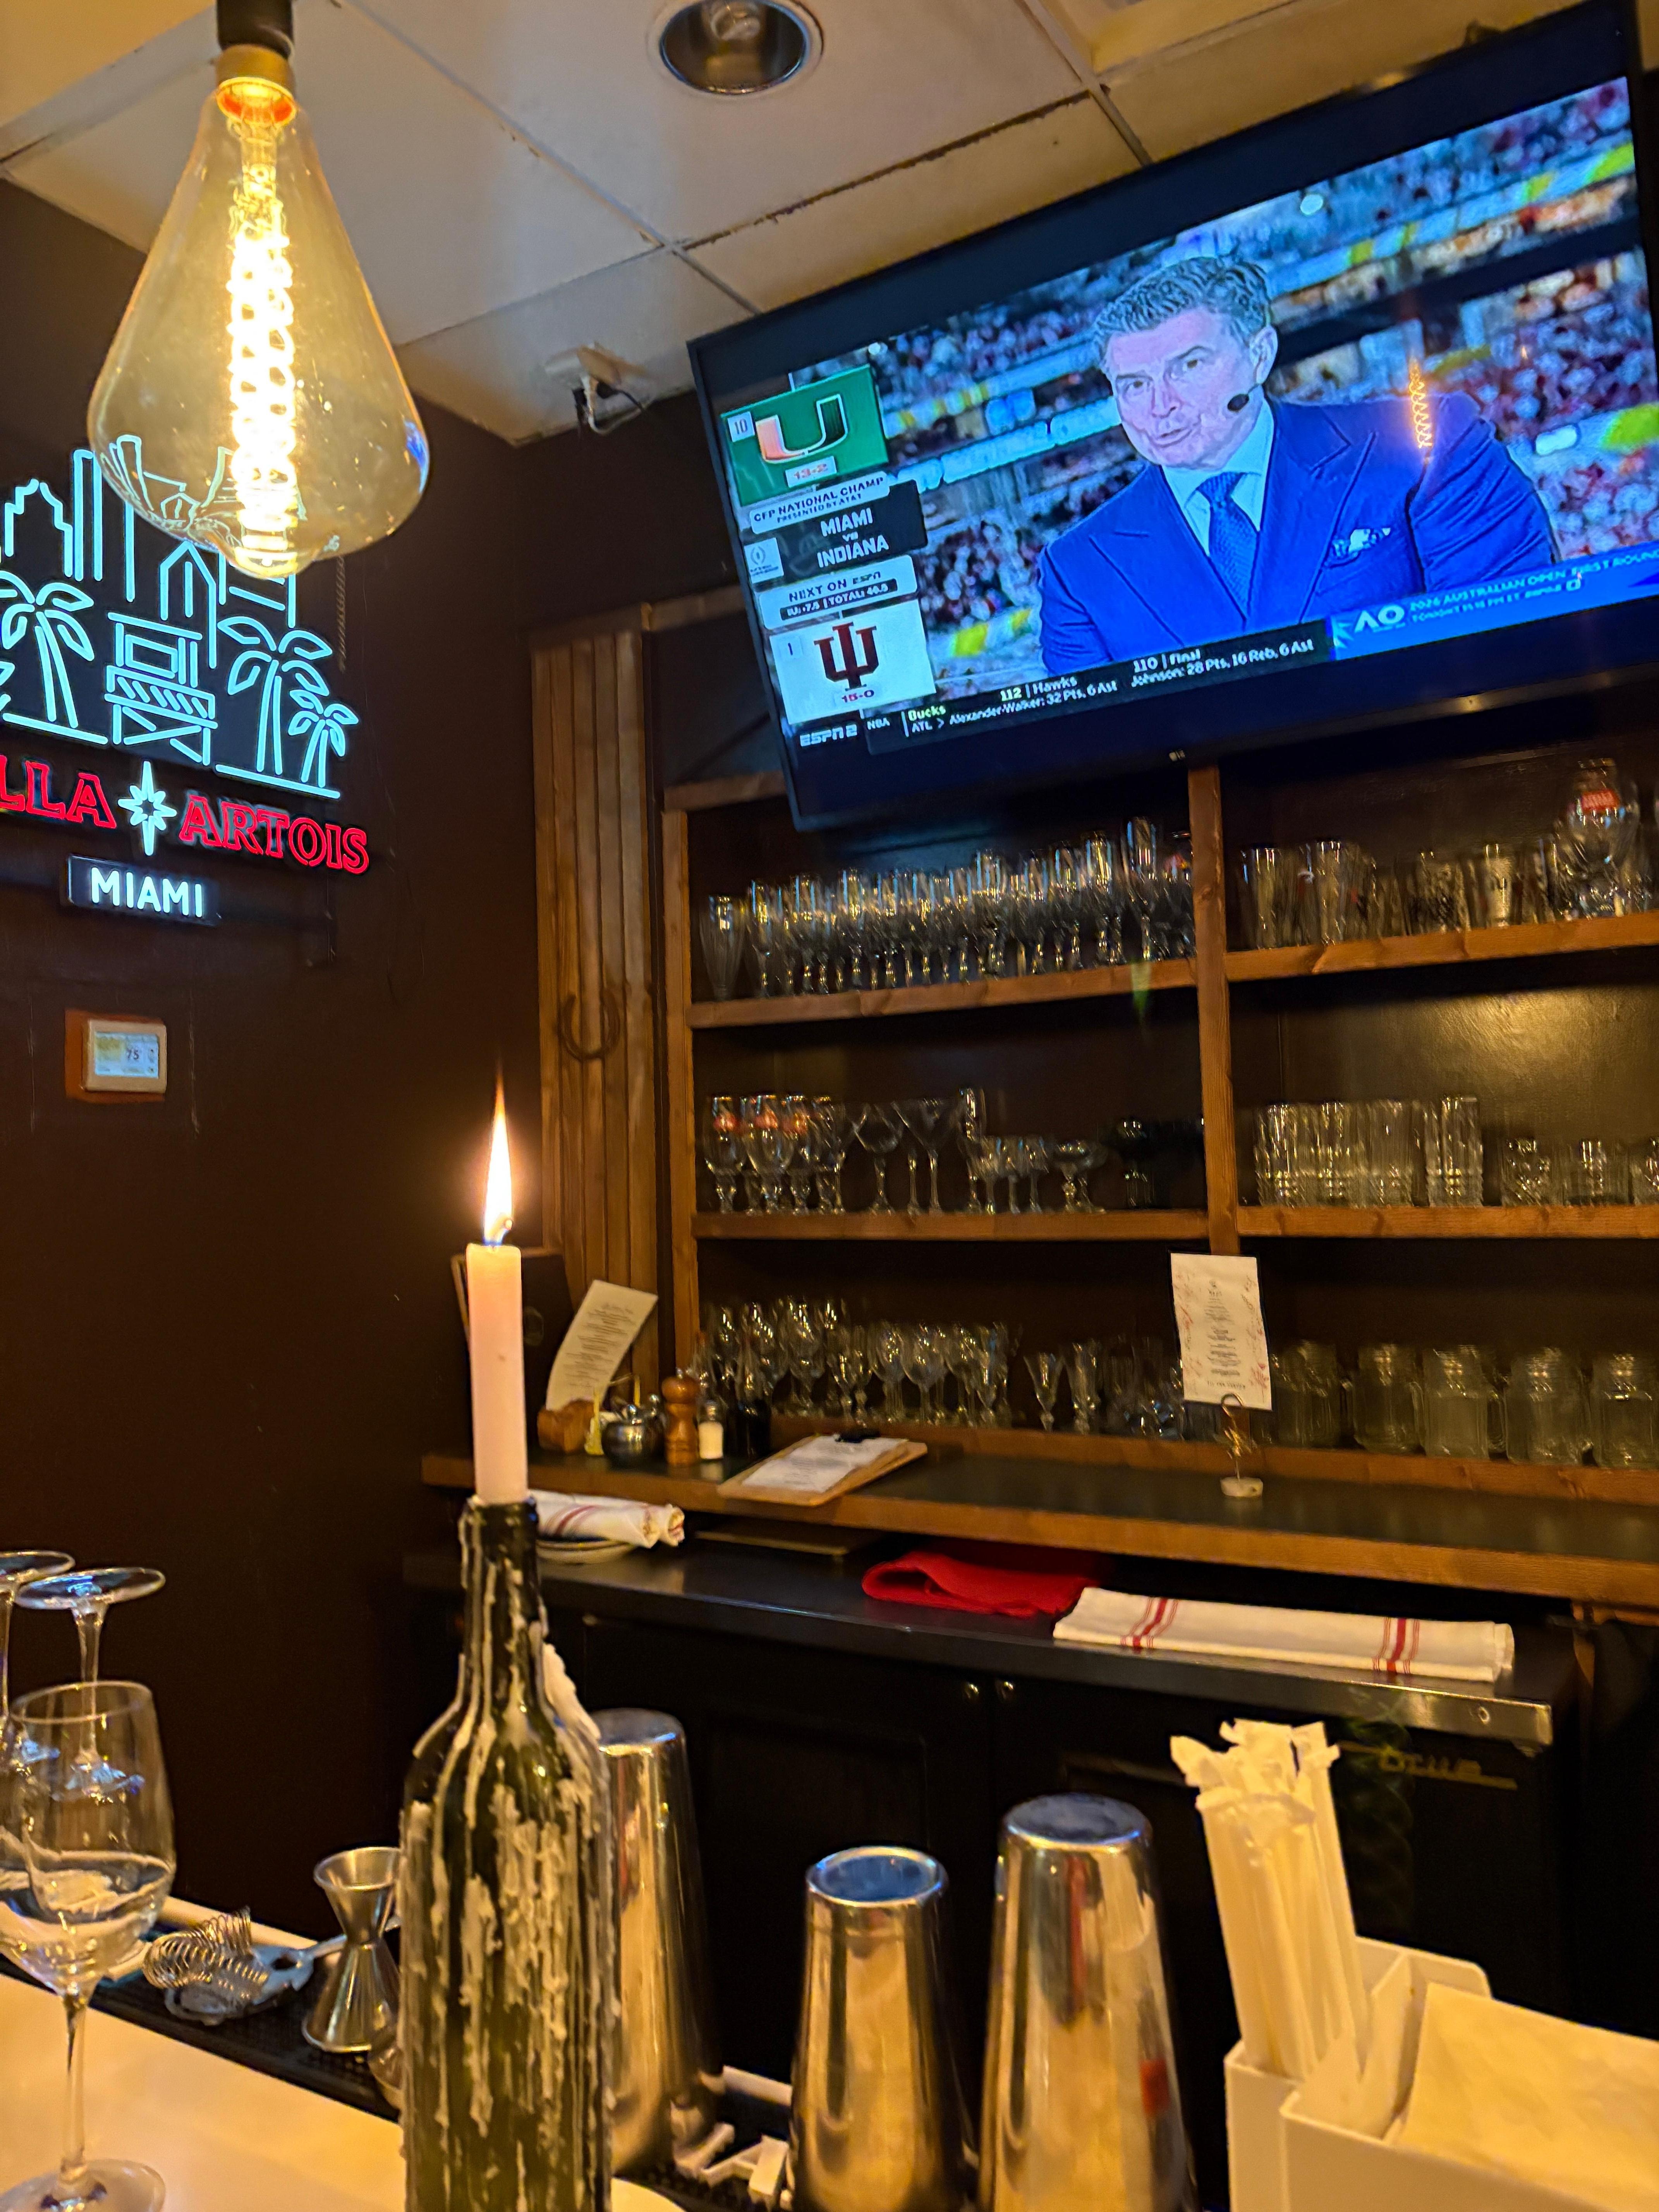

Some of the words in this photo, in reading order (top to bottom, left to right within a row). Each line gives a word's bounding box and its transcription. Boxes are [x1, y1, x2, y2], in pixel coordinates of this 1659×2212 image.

[733, 418, 748, 435] 10
[754, 510, 775, 522] CFP
[779, 491, 837, 515] NATIONAL
[840, 477, 883, 496] CHAMP
[821, 508, 873, 537] MIAMI
[817, 534, 889, 568] INDIANA
[789, 585, 822, 602] NEXT
[827, 579, 847, 591] ON
[1444, 580, 1525, 605] AUSTRALIAN
[1527, 570, 1566, 586] OPEN
[1355, 605, 1405, 632] AO
[908, 705, 946, 721] Bucks
[1000, 687, 1022, 701] 112
[1032, 677, 1077, 695] Hawks
[1133, 656, 1158, 673] 110
[912, 720, 933, 733] ATL
[1187, 662, 1205, 675] 28
[1279, 642, 1290, 656] 6
[800, 724, 857, 747] ESPN2
[867, 717, 890, 730] NBA
[179, 794, 369, 874] ARTOIS
[91, 867, 203, 918] MIAMI
